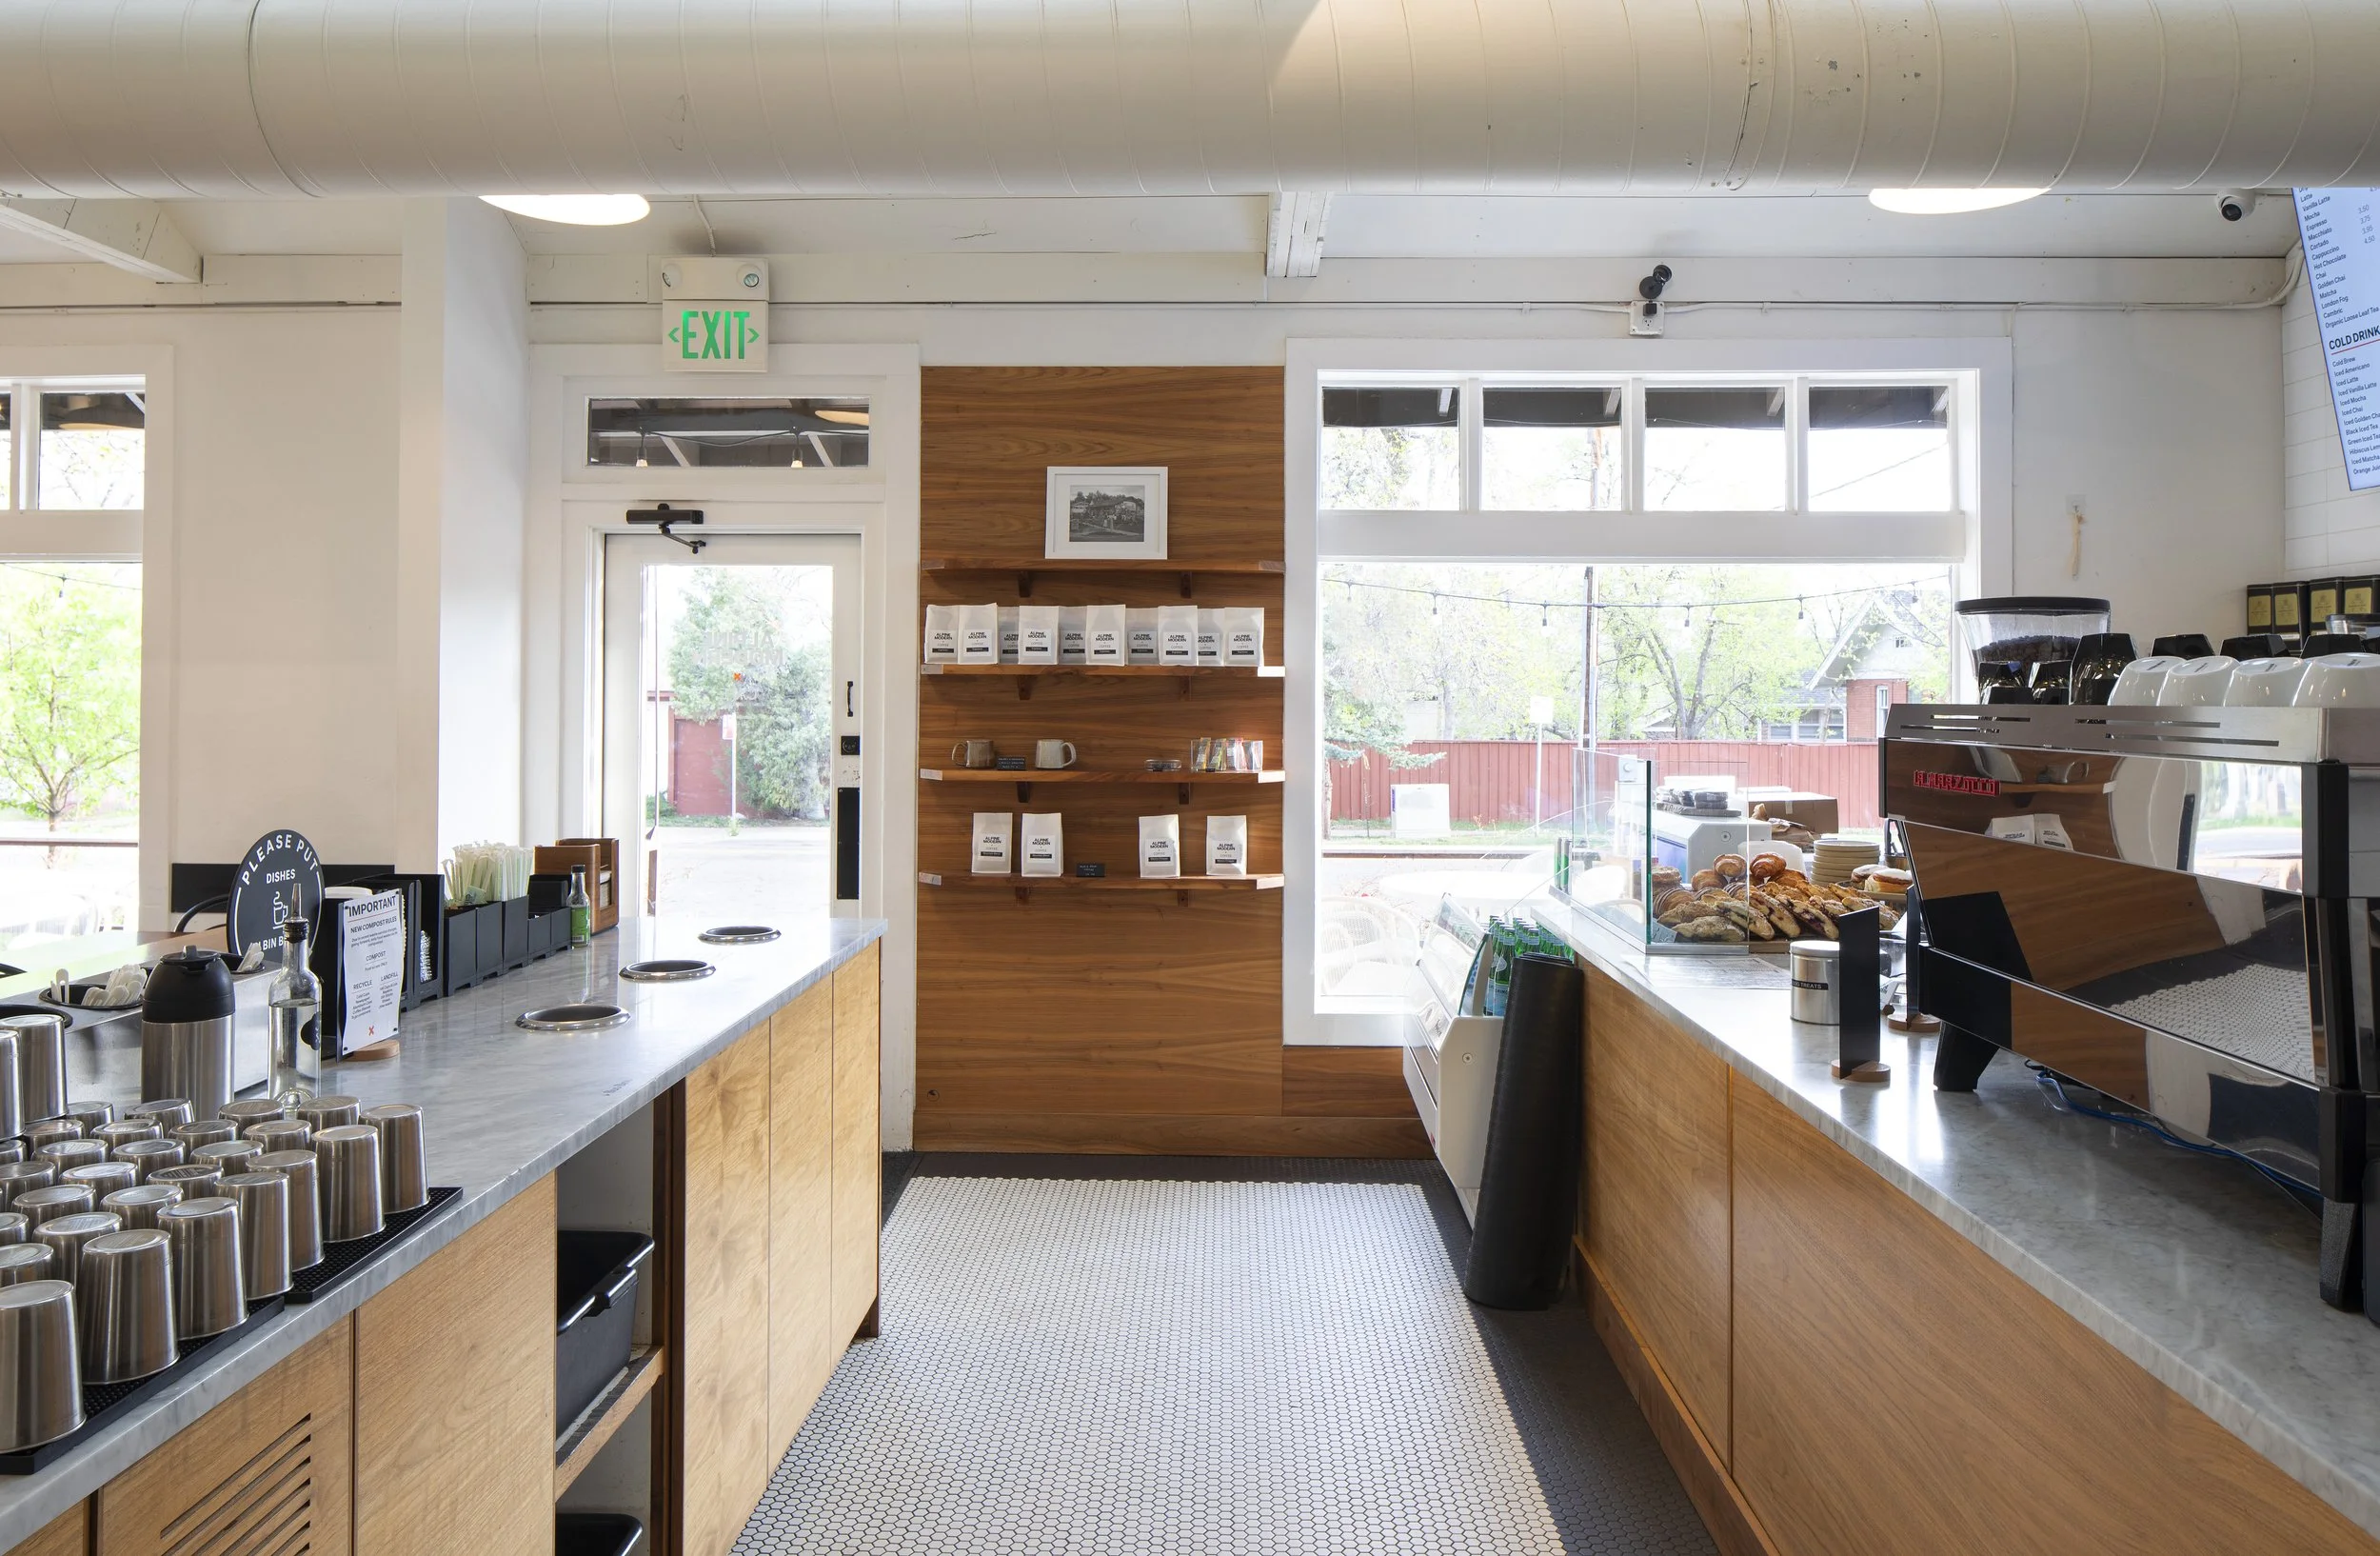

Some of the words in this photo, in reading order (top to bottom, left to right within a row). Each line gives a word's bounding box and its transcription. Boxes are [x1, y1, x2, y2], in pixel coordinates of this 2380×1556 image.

[2302, 202, 2318, 211] Vanilla
[2318, 196, 2330, 205] Latte
[2304, 211, 2320, 221] Mocha
[2306, 219, 2327, 231] Espresso
[2308, 228, 2332, 241] Macchiato
[2310, 239, 2329, 250] Cortado
[2312, 246, 2340, 260] Cappuccino
[2323, 253, 2347, 267] Chocolate
[2315, 271, 2327, 280] Chai
[2317, 280, 2334, 289] Golden
[2334, 274, 2346, 283] Chai
[2319, 289, 2336, 299] Matcha
[2322, 299, 2338, 309] London
[2323, 308, 2343, 318] Cambric
[2325, 318, 2343, 329] Organic
[2344, 312, 2359, 322] Loose
[2358, 309, 2370, 318] Leaf
[682, 310, 750, 360] EXIT
[2329, 335, 2351, 349] COLD
[2332, 359, 2343, 368] Cold
[2345, 363, 2370, 373] Americano
[2350, 395, 2367, 404] Mocha
[242, 834, 291, 886] PLEASE
[297, 839, 318, 870] PUT
[267, 868, 295, 884] DISHES
[348, 895, 396, 917] IMPORTANT
[362, 919, 385, 930] COMPOST
[263, 937, 276, 950] BIN
[366, 951, 387, 961] COMPOST
[353, 980, 372, 989] RECYCLE
[381, 971, 398, 981] LANDFILL
